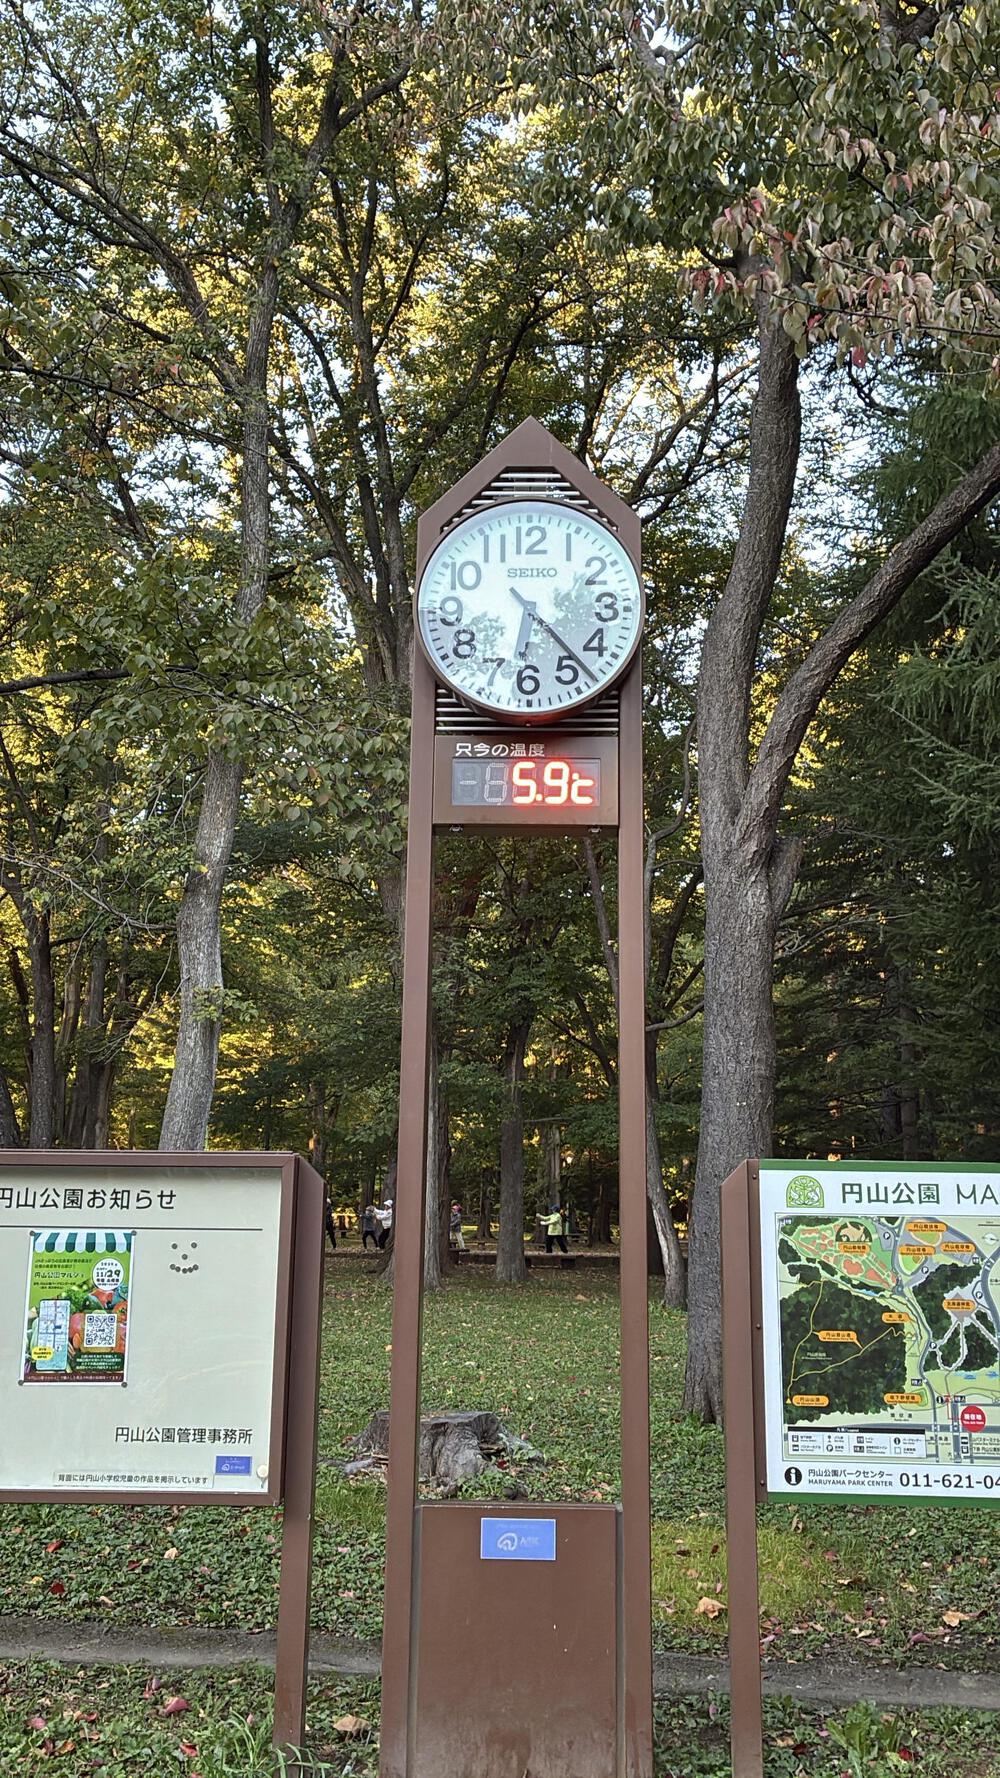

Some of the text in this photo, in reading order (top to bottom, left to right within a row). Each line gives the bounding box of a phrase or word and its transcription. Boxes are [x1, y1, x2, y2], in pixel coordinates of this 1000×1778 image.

[483, 534, 506, 563] 11
[516, 525, 548, 555] 12
[565, 533, 572, 562] 1
[450, 560, 482, 590] 10
[507, 567, 557, 578] SEIKO
[584, 556, 608, 586] 2
[439, 596, 463, 627] 9
[594, 592, 619, 623] 3
[452, 629, 477, 659] 8
[582, 628, 608, 657] 4
[482, 656, 506, 687] 7
[516, 664, 541, 696] 6
[554, 655, 579, 686] 5
[455, 742, 545, 757] 只今の温度
[0, 1187, 177, 1211] 円山公園お知らせ
[842, 1182, 940, 1205] 円山公園
[115, 1426, 253, 1445] 円山公園管理事務所
[808, 1469, 893, 1478] 円山公園パークセンター
[808, 1478, 846, 1486] MARUYAMA
